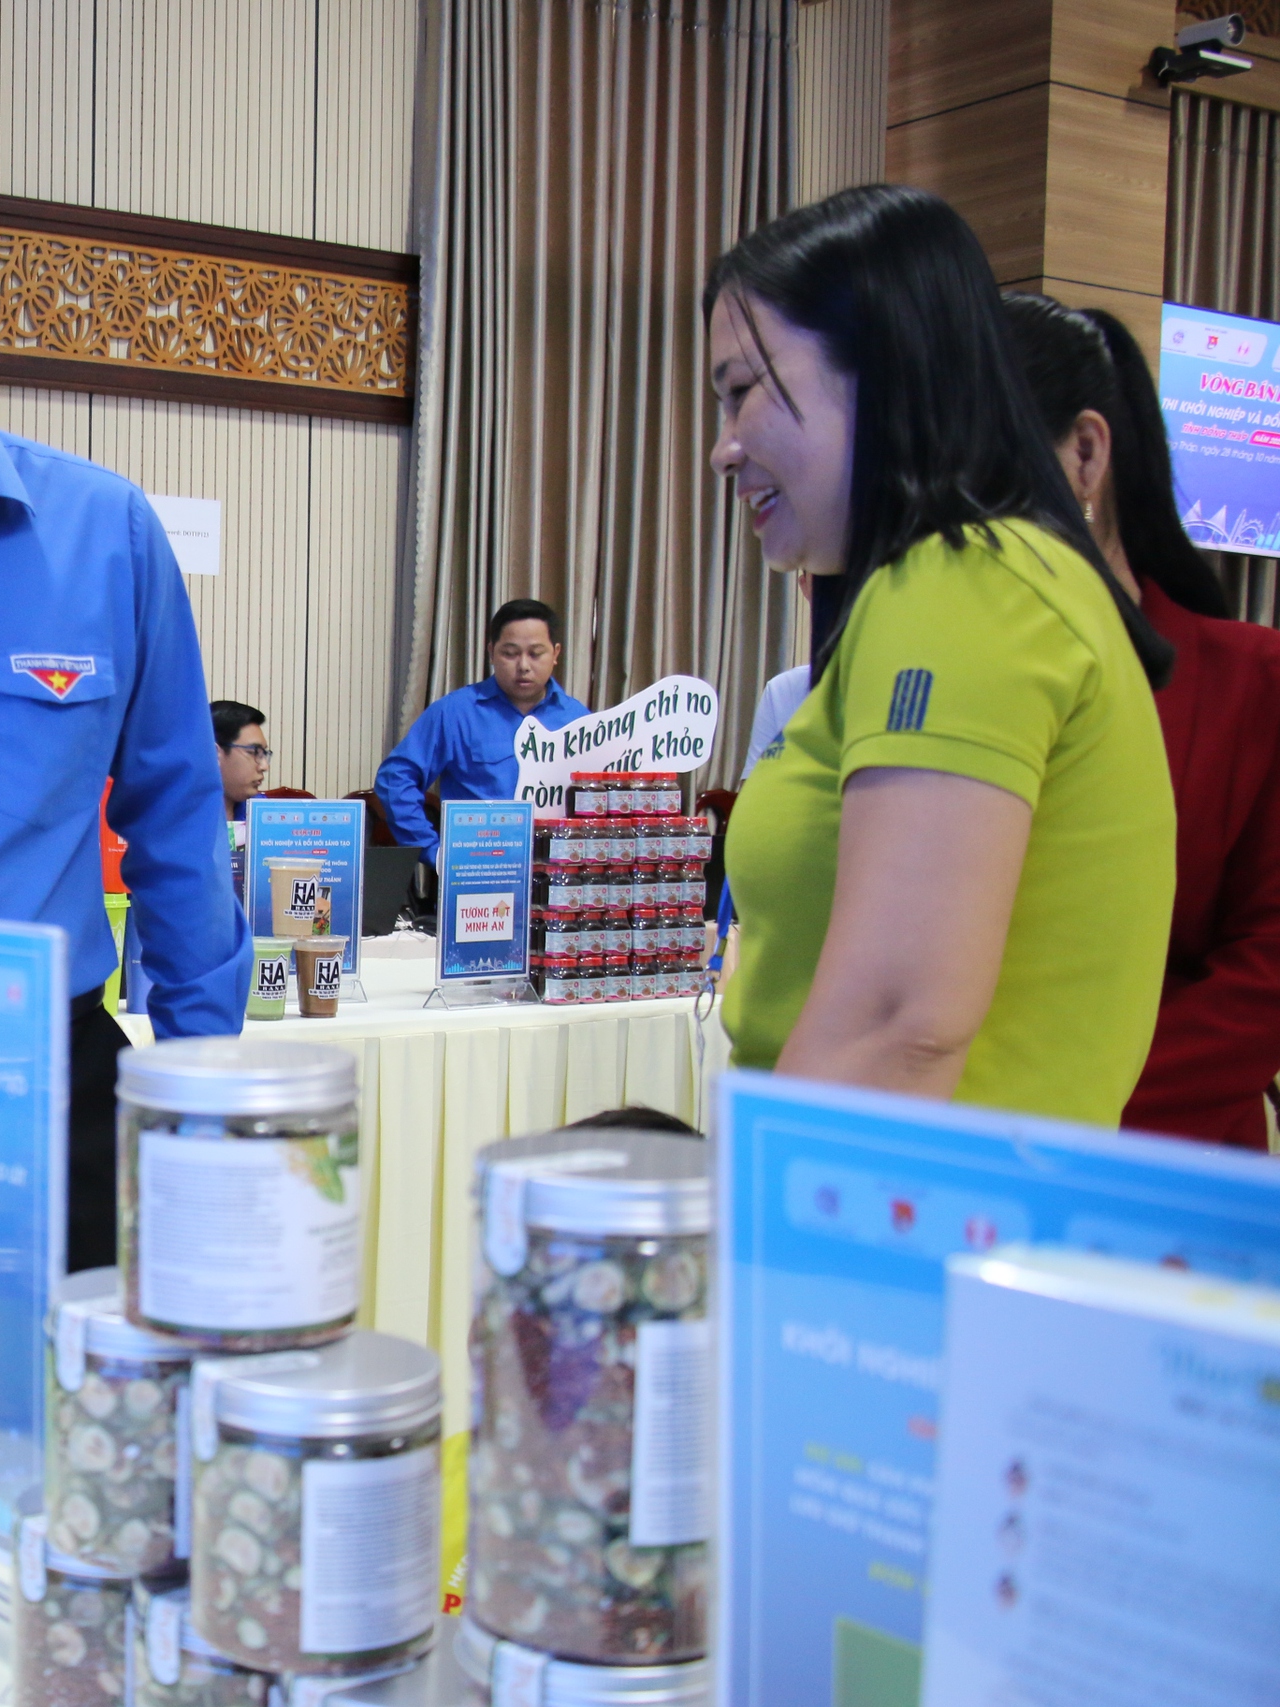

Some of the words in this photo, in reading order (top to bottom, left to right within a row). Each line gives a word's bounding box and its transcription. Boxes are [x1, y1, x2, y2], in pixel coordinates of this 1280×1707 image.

[1162, 398, 1178, 411] THI
[1207, 406, 1246, 424] NGHIỆP
[520, 724, 555, 763] Ăn
[564, 710, 636, 760] không
[644, 685, 679, 723] chỉ
[687, 692, 711, 716] no
[522, 781, 563, 808] còn
[652, 727, 704, 762] khỏe
[461, 907, 489, 919] TƯƠNG
[465, 922, 488, 932] MINH
[491, 921, 504, 931] AN
